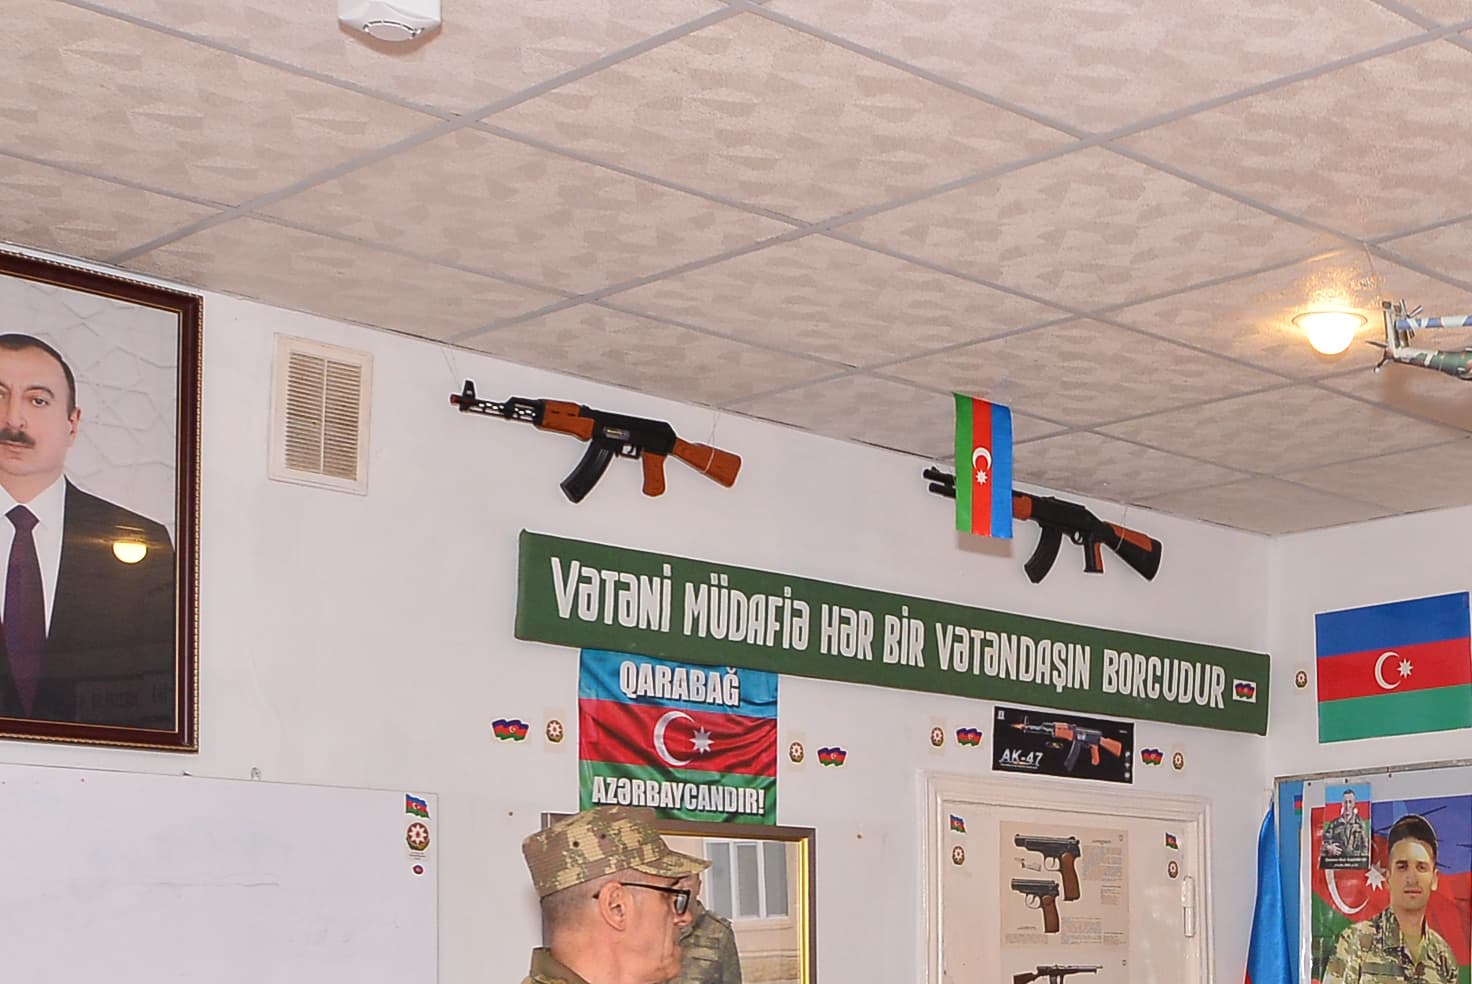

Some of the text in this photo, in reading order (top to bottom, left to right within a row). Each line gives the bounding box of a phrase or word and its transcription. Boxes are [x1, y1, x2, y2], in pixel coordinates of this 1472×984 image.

[550, 557, 1225, 709] VƏTƏNİ MÜDAFİƏ HƏR BİR VƏTƏNDAŞIN BORCUDUR
[619, 659, 740, 707] QARABAĞ
[1001, 749, 1043, 765] AK-47
[591, 776, 766, 815] AZƏRBAYCANDIR!
